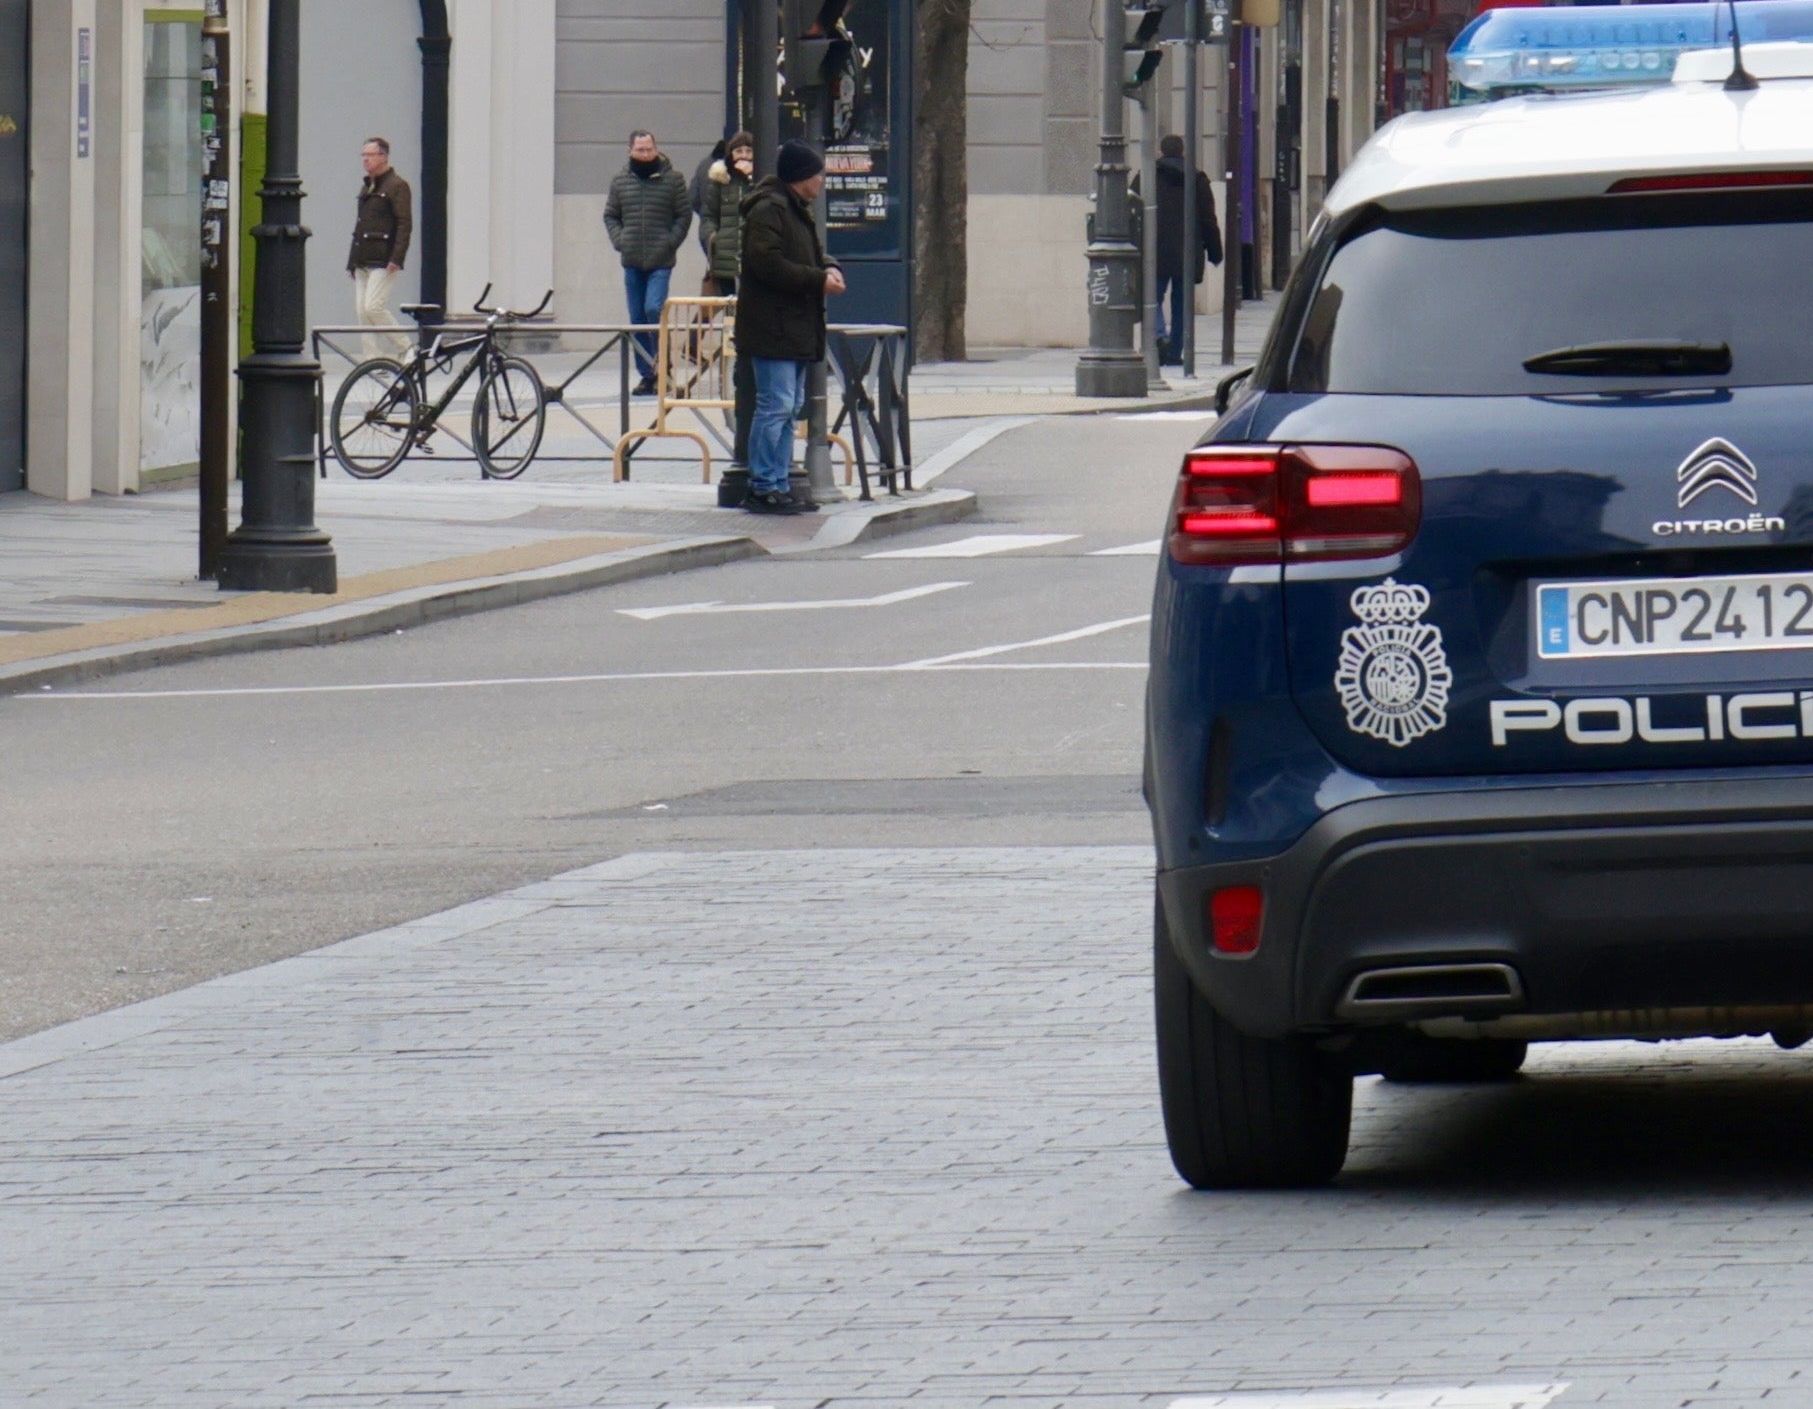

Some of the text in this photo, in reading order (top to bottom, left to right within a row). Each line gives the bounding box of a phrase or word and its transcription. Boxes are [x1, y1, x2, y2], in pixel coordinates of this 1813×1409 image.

[869, 193, 883, 207] 23
[1651, 512, 1785, 536] CITROËN
[1549, 628, 1562, 644] E
